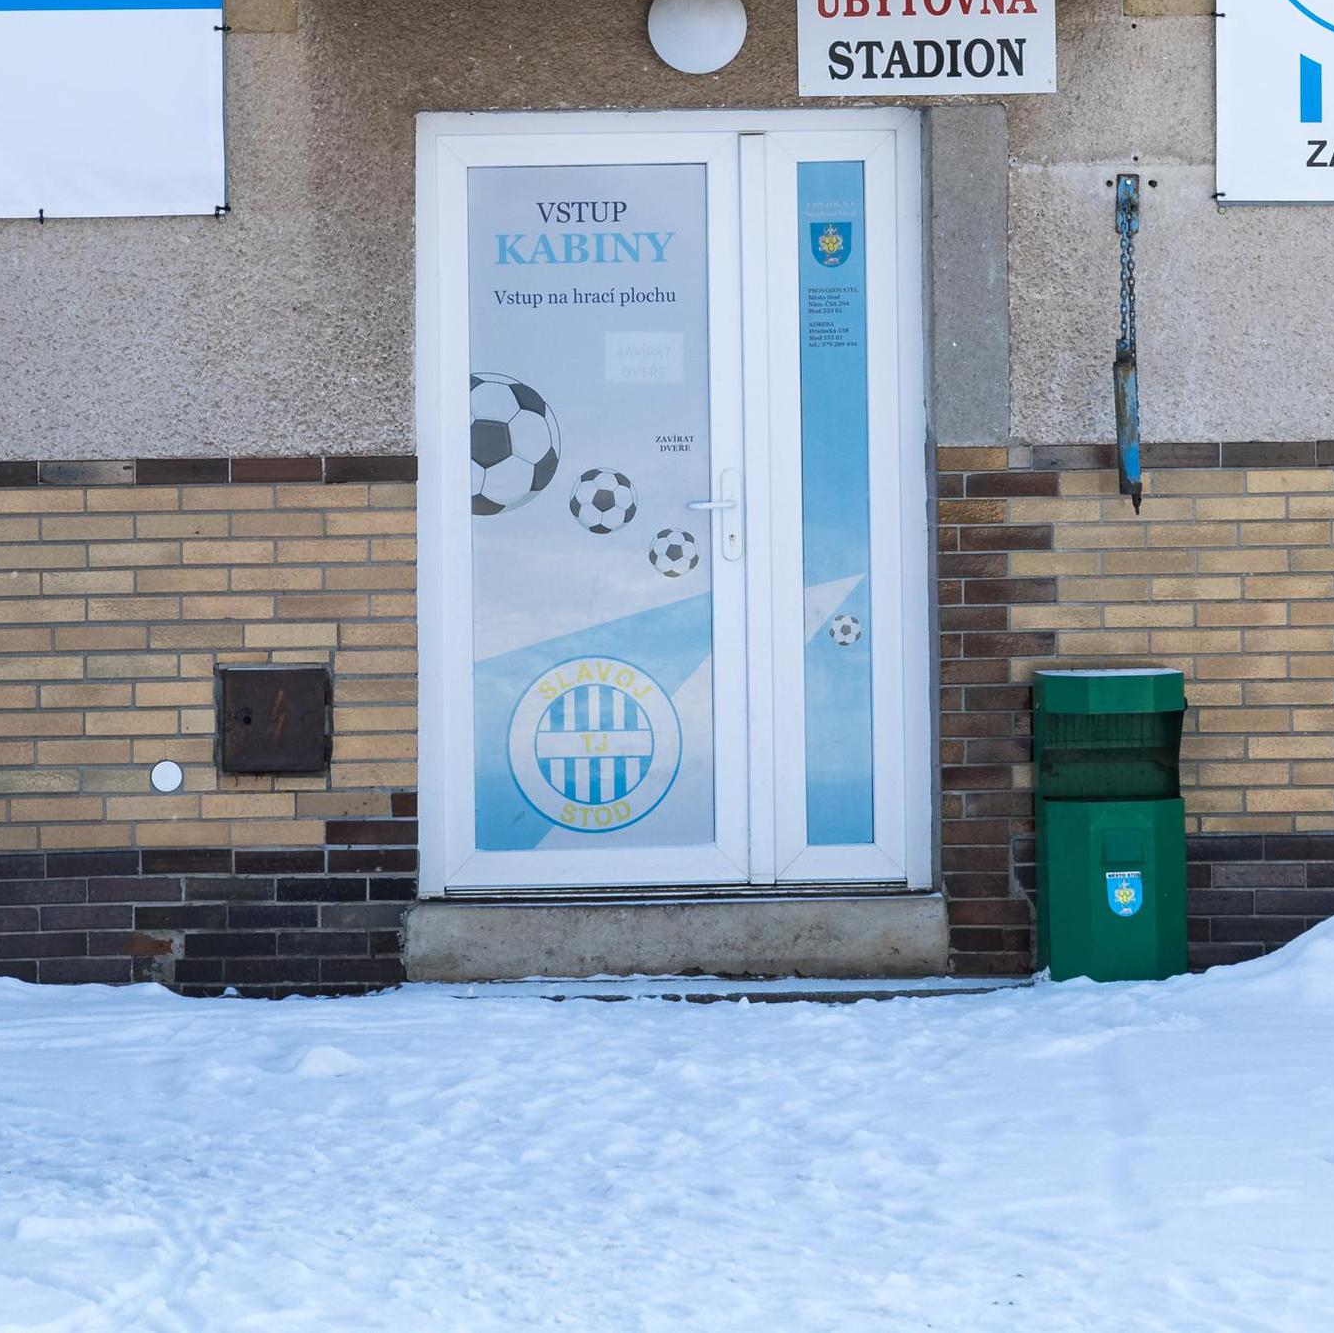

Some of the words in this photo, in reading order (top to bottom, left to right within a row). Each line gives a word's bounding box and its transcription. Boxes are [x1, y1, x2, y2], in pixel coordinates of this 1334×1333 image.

[828, 38, 1027, 80] STADION
[536, 201, 627, 223] VSTUP
[495, 231, 677, 265] KABINY
[494, 289, 543, 308] Vstup
[548, 292, 568, 304] na
[573, 287, 615, 304] hrací
[620, 287, 677, 306] plochu
[655, 433, 695, 443] ZAVÍRAT
[660, 444, 691, 453] DVEŘE
[538, 661, 652, 700] SLAVOJ
[581, 733, 609, 753] TJ
[559, 800, 632, 827] STOD
